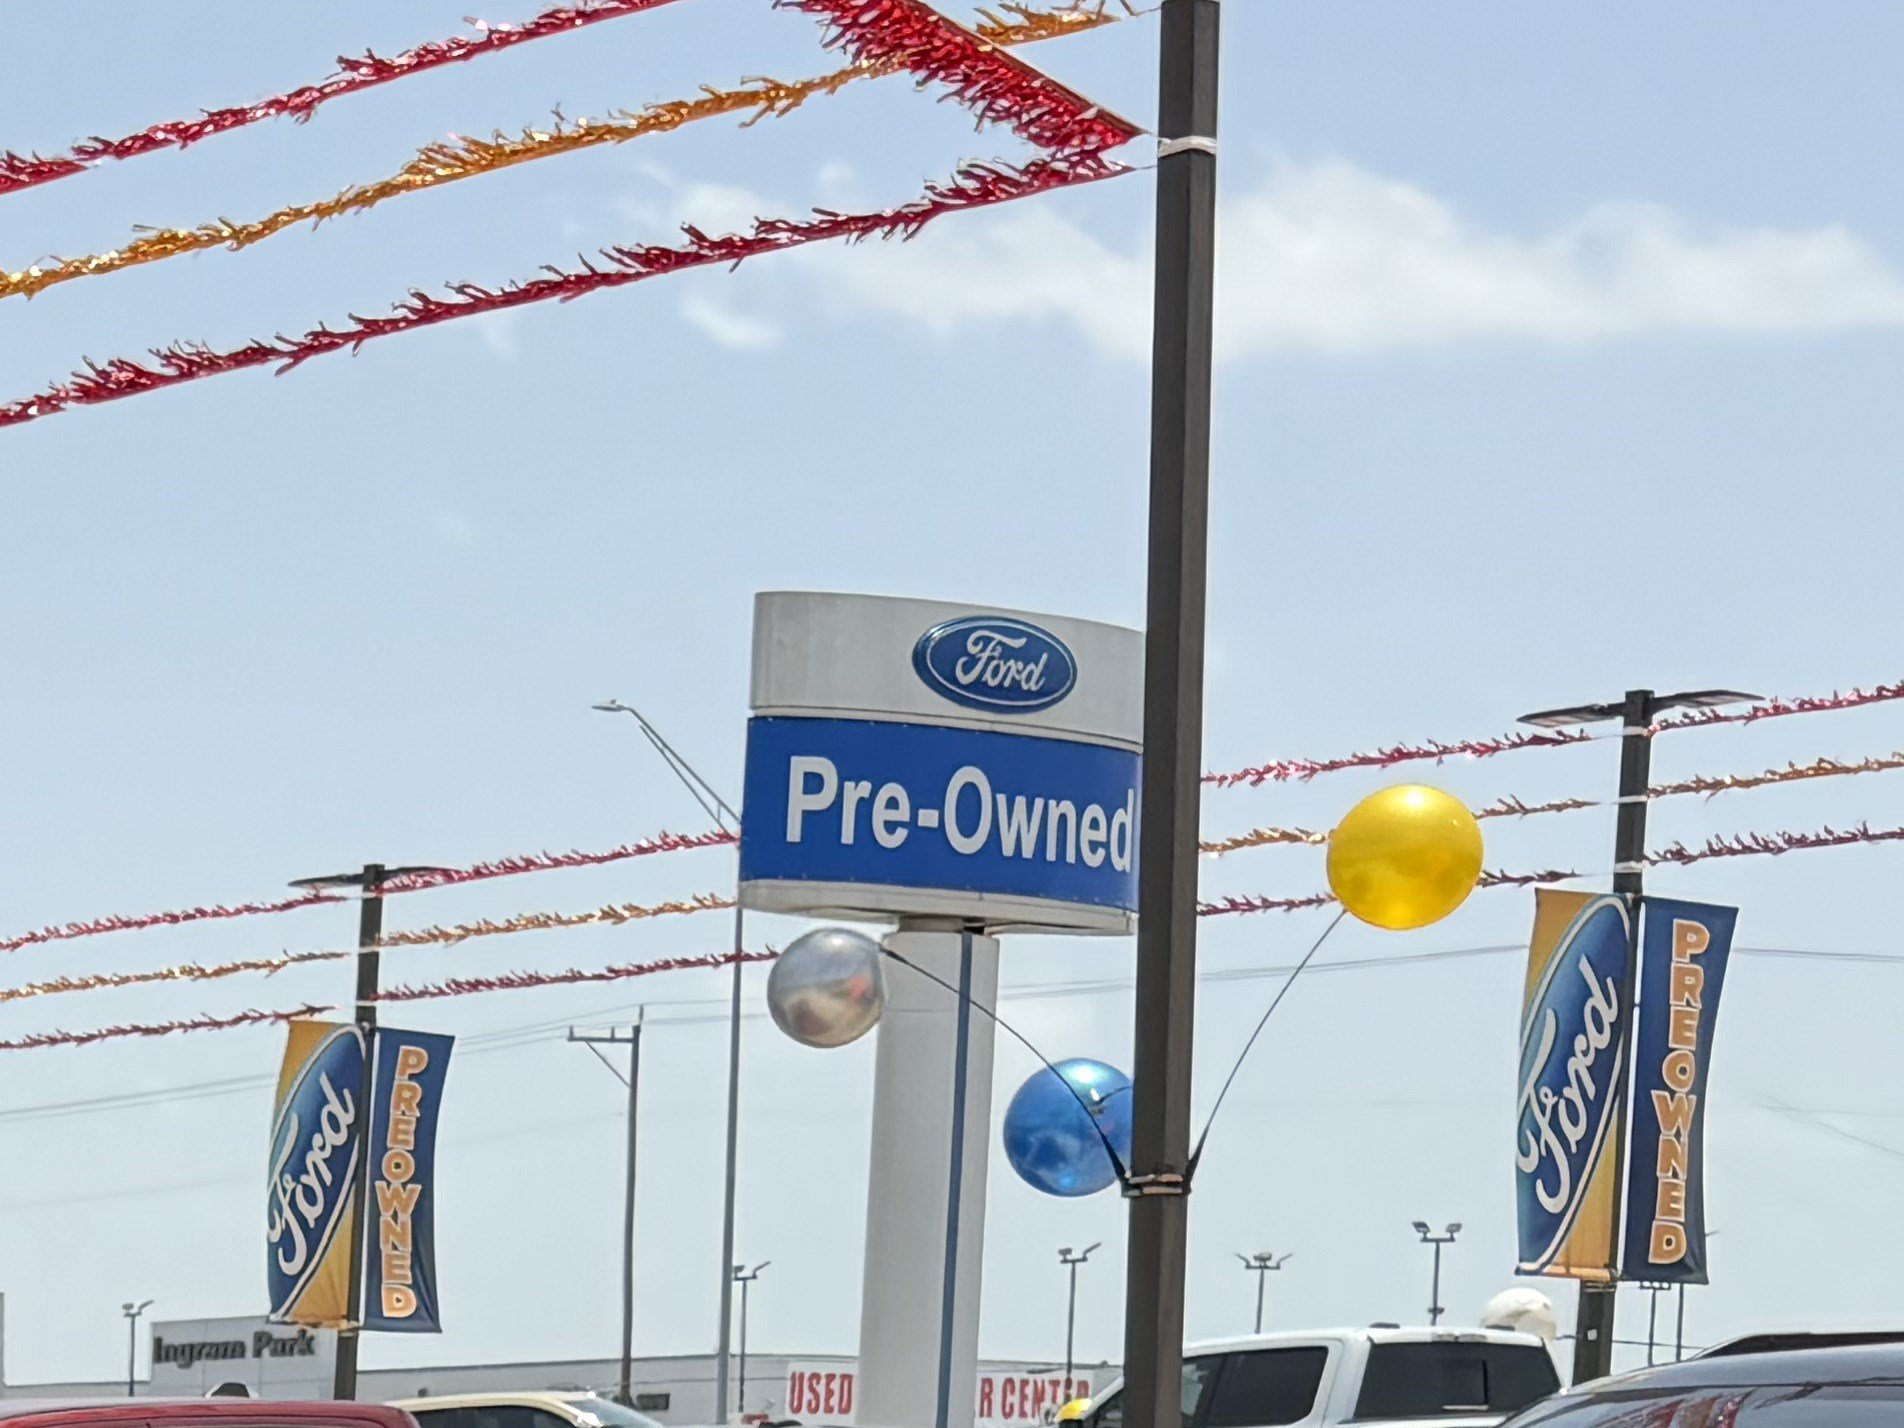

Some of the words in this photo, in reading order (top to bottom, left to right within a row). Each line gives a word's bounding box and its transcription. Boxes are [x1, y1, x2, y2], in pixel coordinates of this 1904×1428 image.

[955, 630, 1048, 692] Ford
[786, 755, 1134, 874] Pre-Owned
[1517, 953, 1620, 1214] Ford
[1648, 917, 1711, 1265] PREOWNED
[267, 1071, 356, 1276] Ford
[373, 1044, 430, 1318] PREOWNED
[152, 1335, 247, 1370] Ingram
[252, 1328, 316, 1359] Park
[789, 1371, 854, 1415] USED
